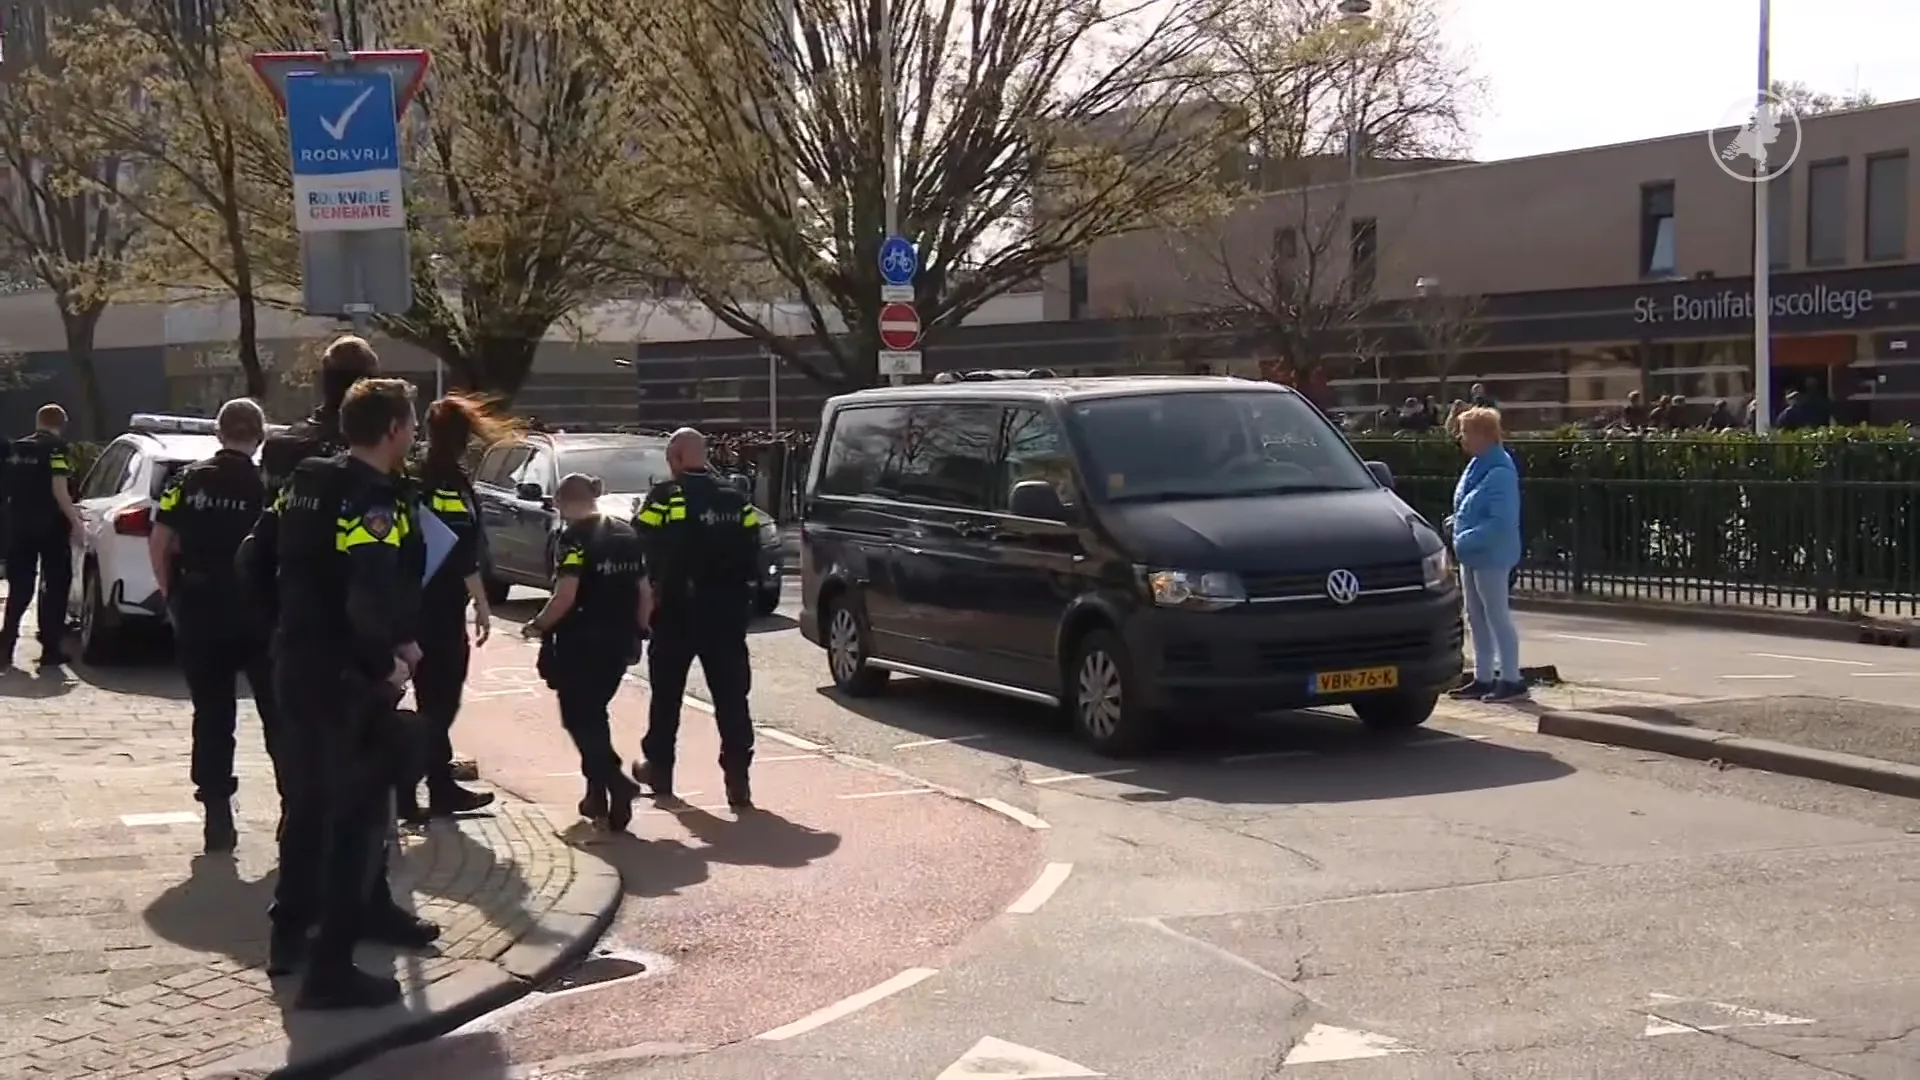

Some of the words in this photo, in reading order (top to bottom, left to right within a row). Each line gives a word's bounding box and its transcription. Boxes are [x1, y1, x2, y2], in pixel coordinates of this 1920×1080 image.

[301, 148, 389, 162] ROOKVRIJ
[310, 205, 391, 219] GENERATIE
[1634, 297, 1664, 323] St.
[1673, 285, 1873, 321] Bonifatuscollege
[1320, 669, 1393, 690] VBR-76-K
